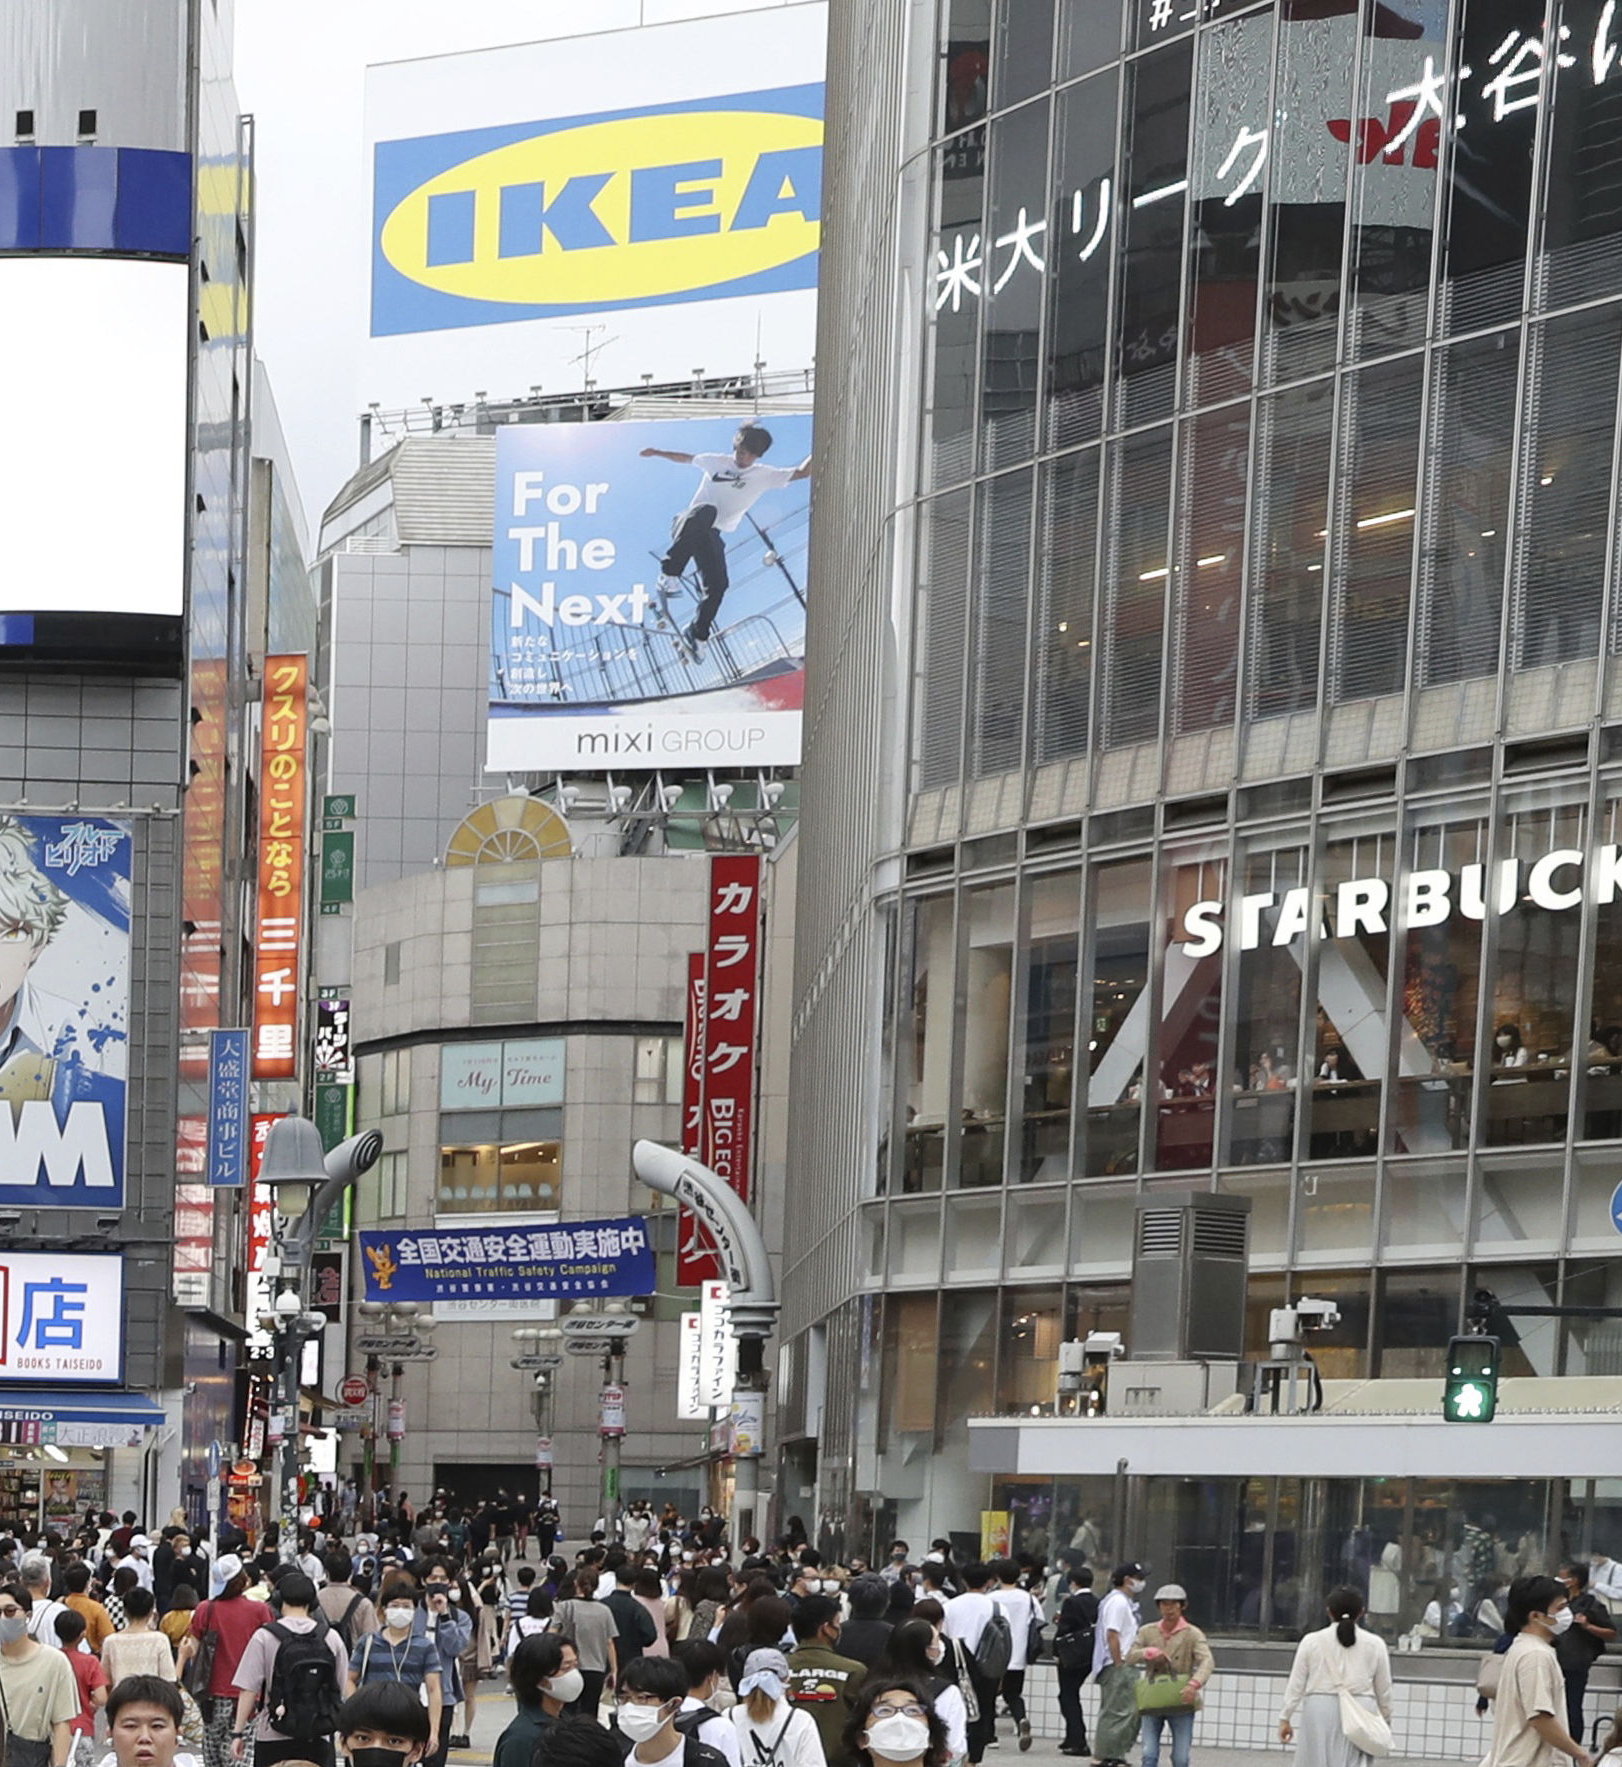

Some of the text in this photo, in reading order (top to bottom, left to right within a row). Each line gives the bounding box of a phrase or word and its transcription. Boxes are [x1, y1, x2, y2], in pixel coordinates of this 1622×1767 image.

[934, 0, 1622, 312] 米大リーグ 大谷
[425, 145, 824, 268] IKEA
[514, 471, 609, 517] For
[508, 521, 616, 573] The
[510, 635, 548, 648] 新たな
[510, 648, 638, 664] コミュニケーションを
[509, 682, 573, 695] 次の世界へ
[510, 667, 547, 681] 創造し
[577, 723, 766, 754] mixi GROUP
[267, 664, 300, 898] クスリのことなら
[61, 821, 124, 847] ブルー
[1181, 843, 1622, 958] STARBUCK
[258, 917, 297, 1060] 三千里
[708, 882, 753, 1074] カラオケ
[457, 1068, 552, 1095] My Time
[216, 1039, 241, 1179] 大盛堂商事ビル
[396, 1225, 645, 1266] 全国交通安全運動実施中
[425, 1262, 617, 1279] National Traffic Safety Campaign
[17, 1357, 104, 1371] BOOKS TAISEIDO
[789, 1667, 849, 1682] LARGE
